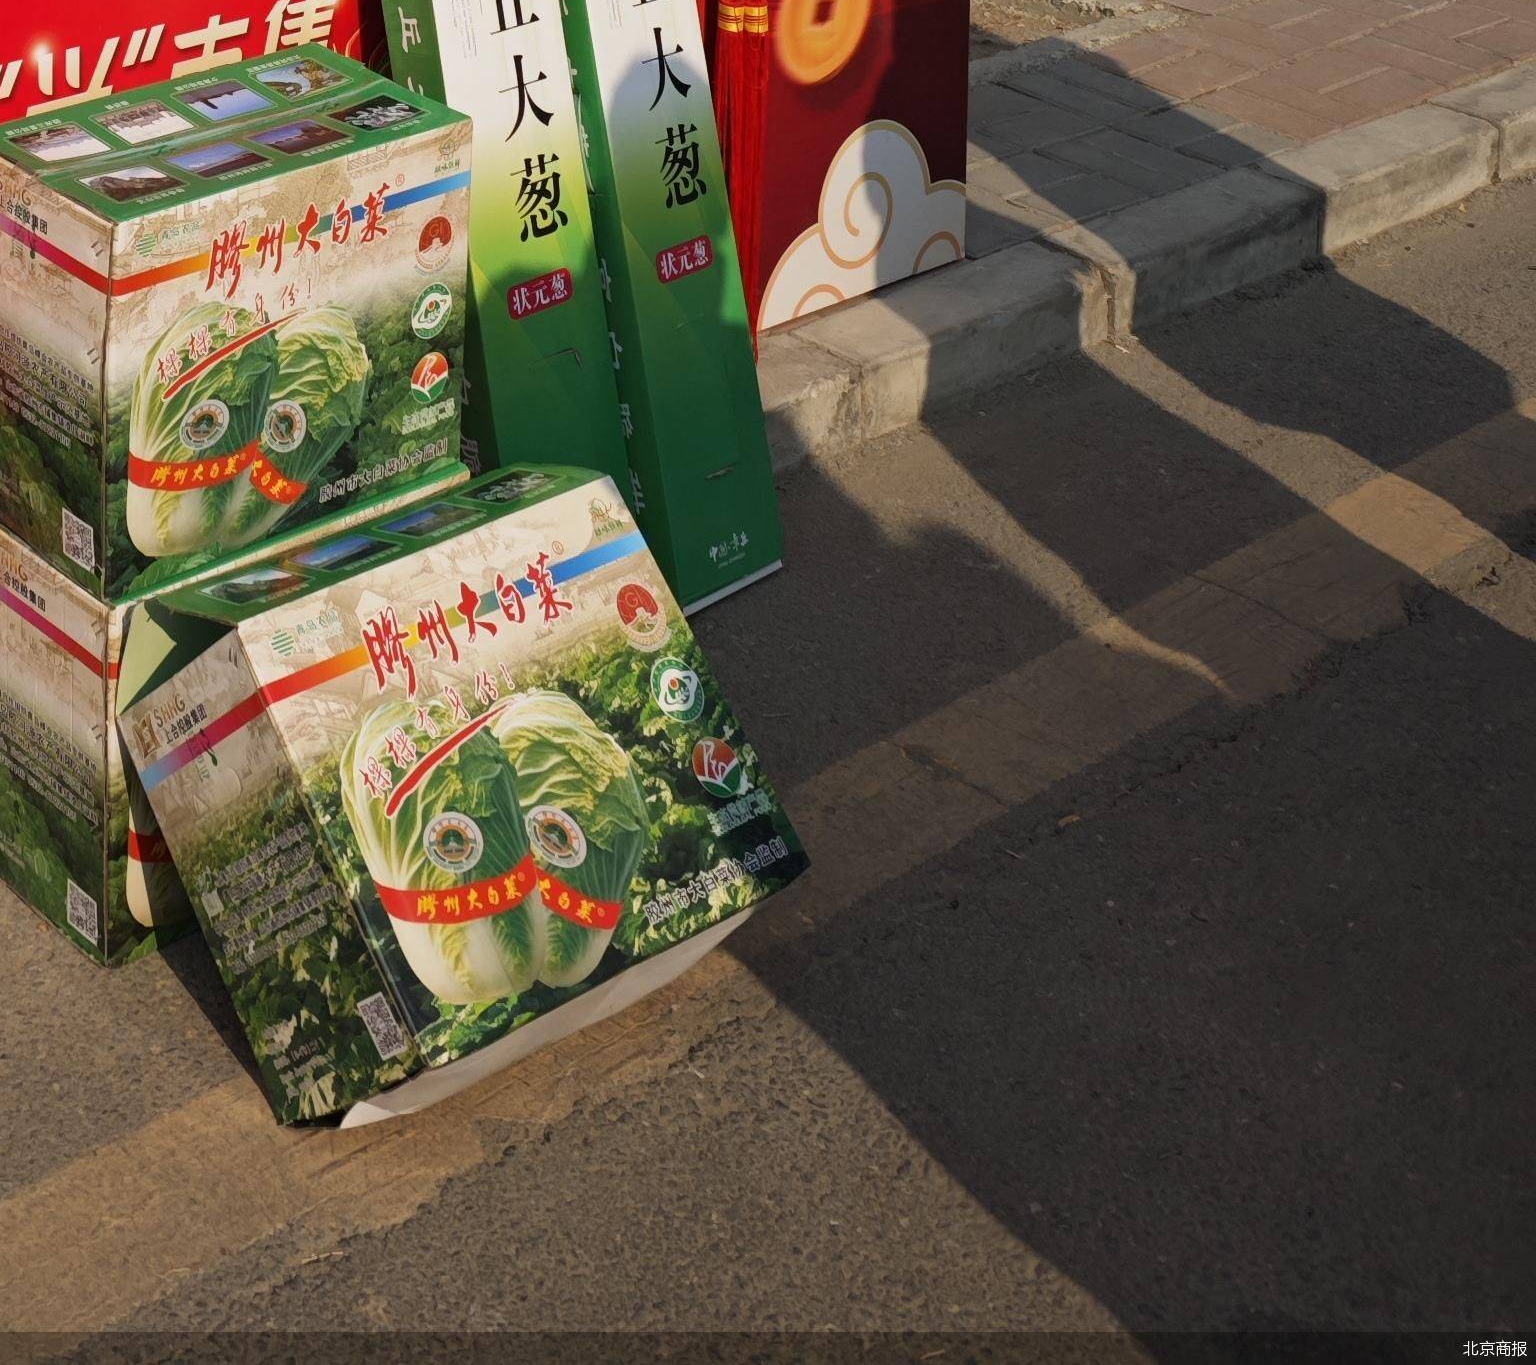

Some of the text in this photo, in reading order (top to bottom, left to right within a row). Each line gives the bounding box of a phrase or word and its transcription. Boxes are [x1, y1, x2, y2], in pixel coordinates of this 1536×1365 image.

[660, 241, 710, 279] 状元葱
[512, 272, 569, 315] 状元葱
[319, 438, 449, 504] 胶州市大白菜协会监制
[642, 836, 789, 926] 胶州市大白菜协会监制
